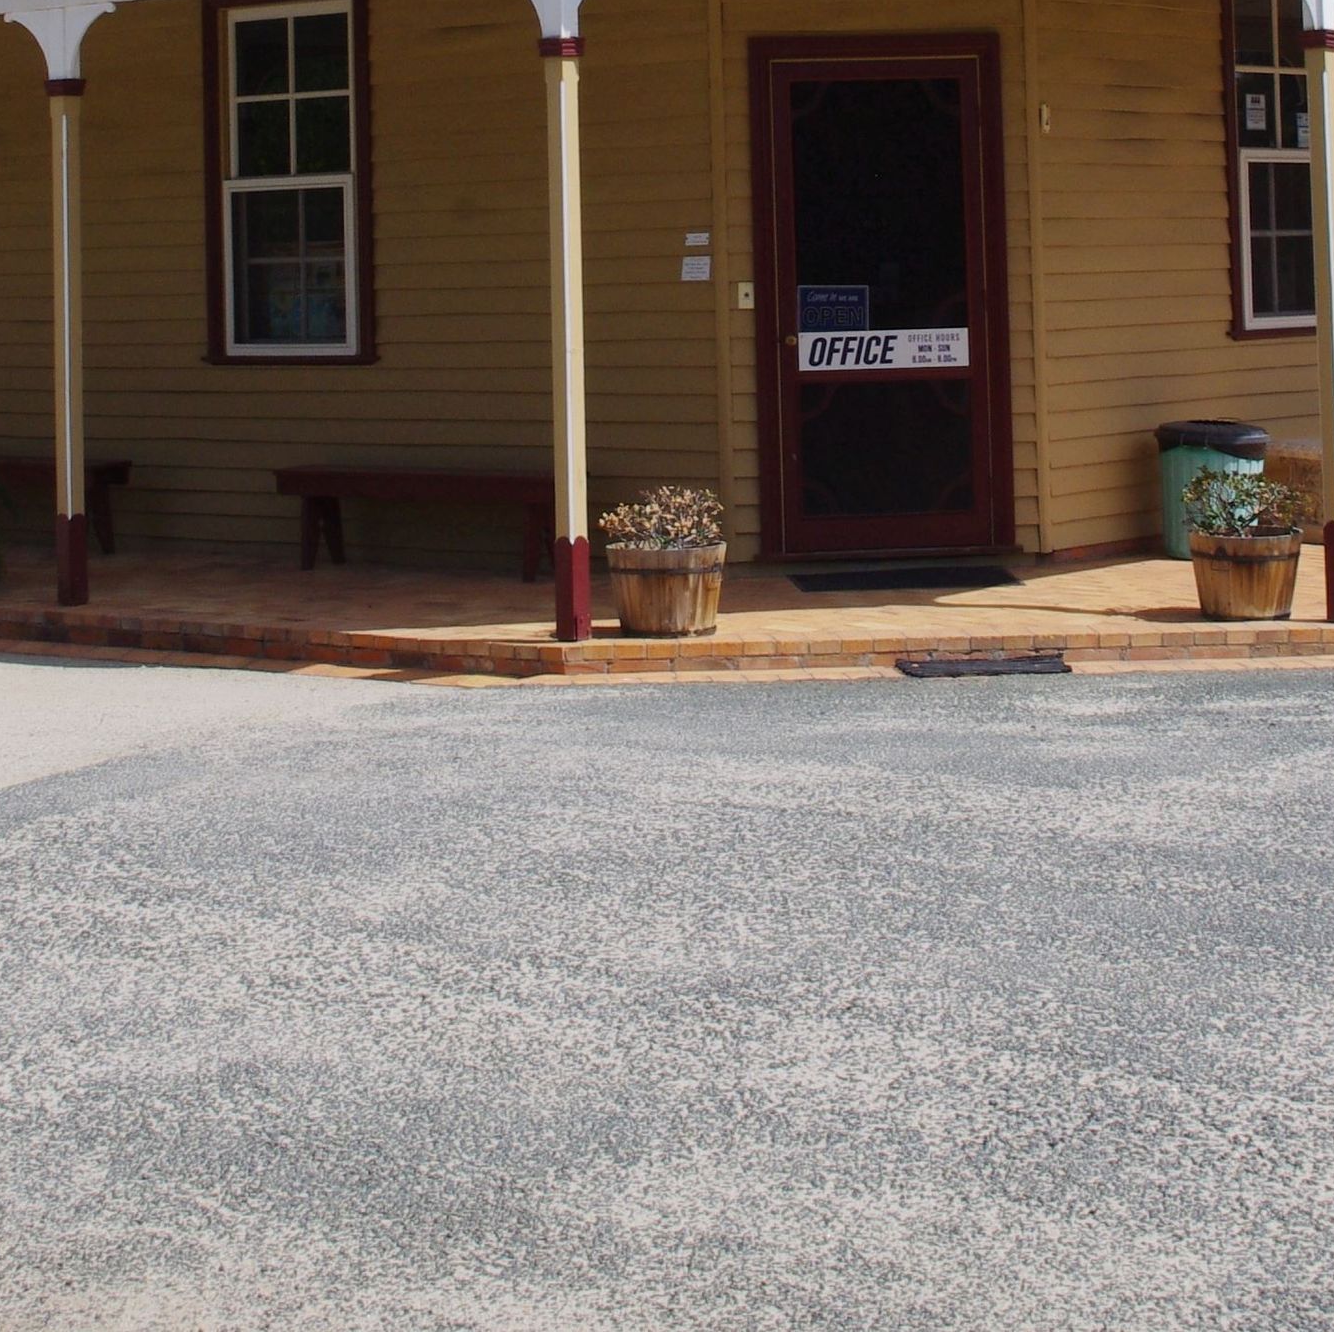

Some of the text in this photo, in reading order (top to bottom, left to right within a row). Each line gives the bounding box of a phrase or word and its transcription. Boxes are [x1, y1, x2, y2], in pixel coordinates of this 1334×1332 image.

[803, 306, 864, 327] OPEN
[908, 333, 960, 342] OFFICE HOURS
[809, 335, 897, 367] OFFICE
